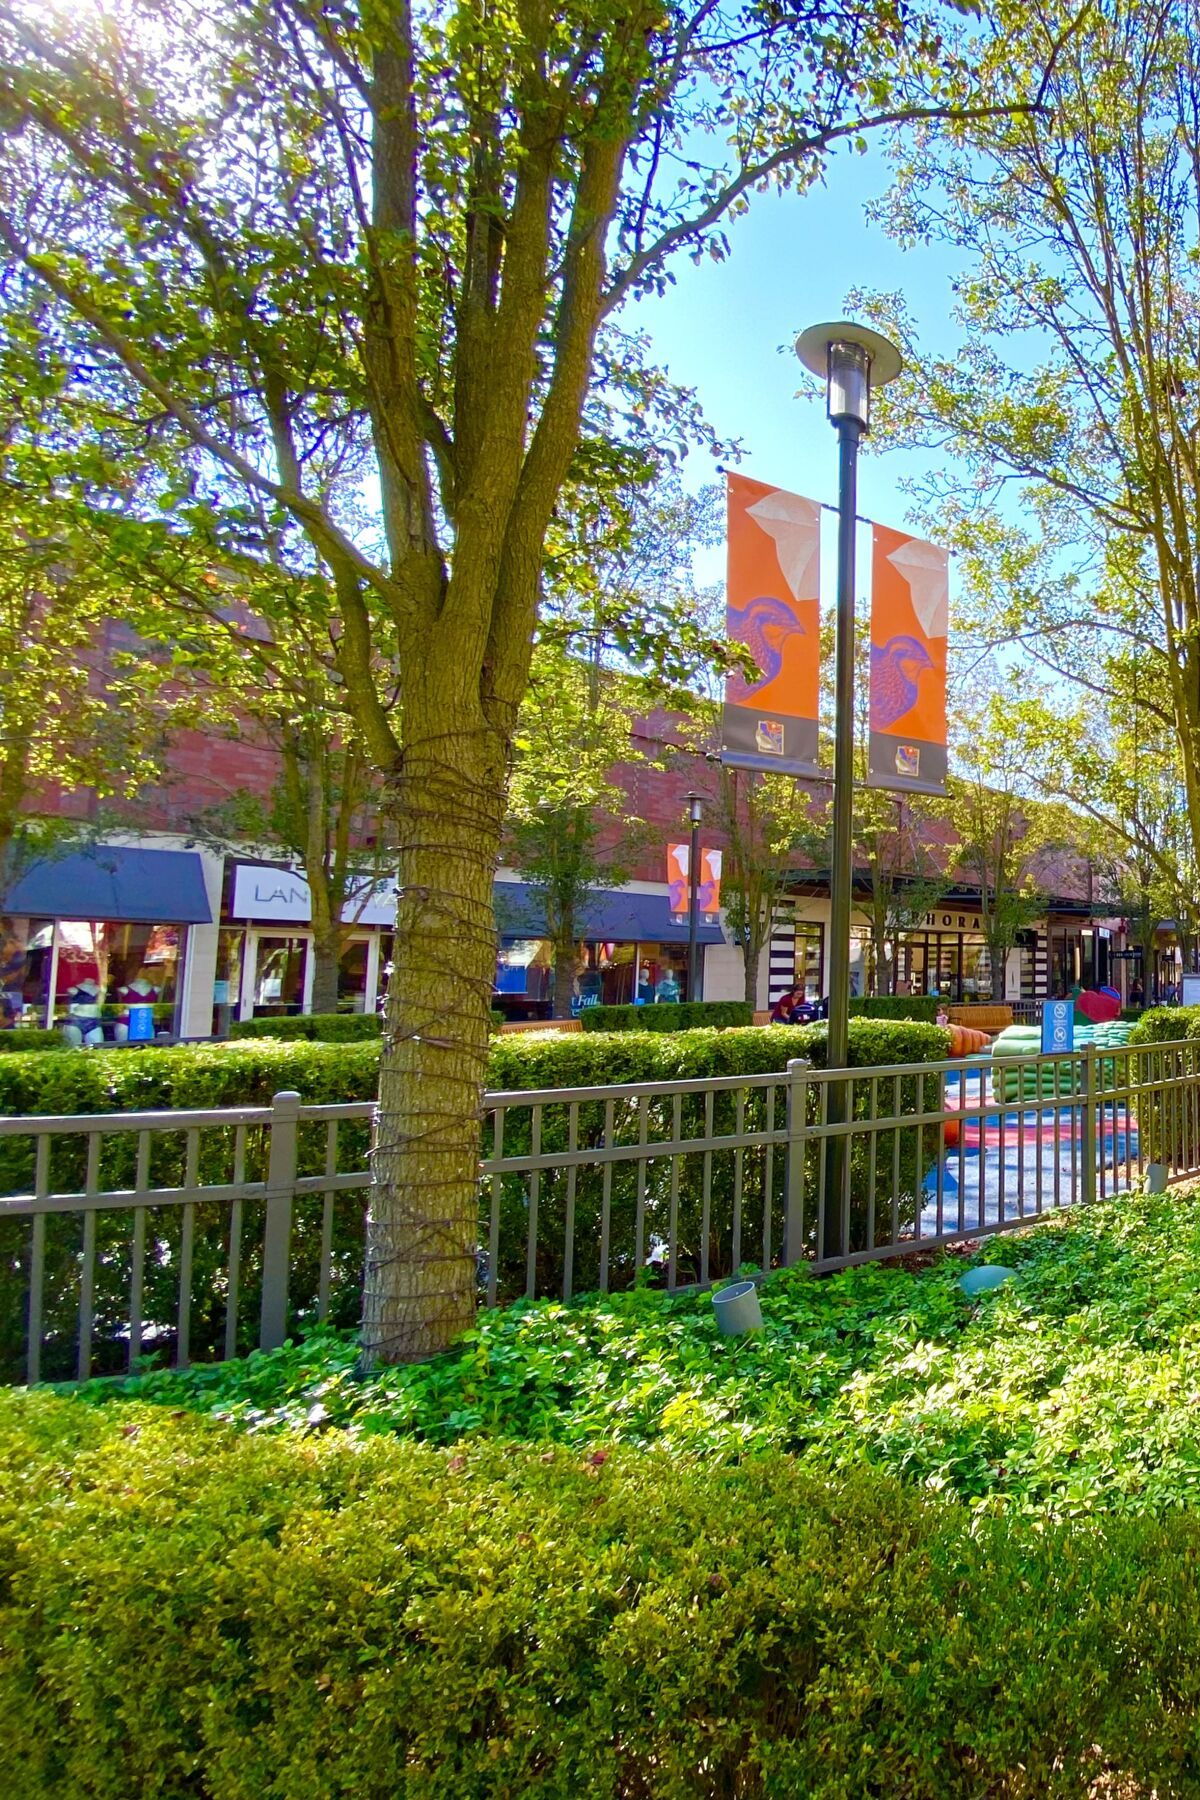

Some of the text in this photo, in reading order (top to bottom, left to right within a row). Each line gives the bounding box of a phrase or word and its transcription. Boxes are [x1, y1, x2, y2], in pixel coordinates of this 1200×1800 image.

[255, 883, 308, 904] LAN
[912, 911, 980, 929] HORA
[577, 993, 599, 1006] Fall
